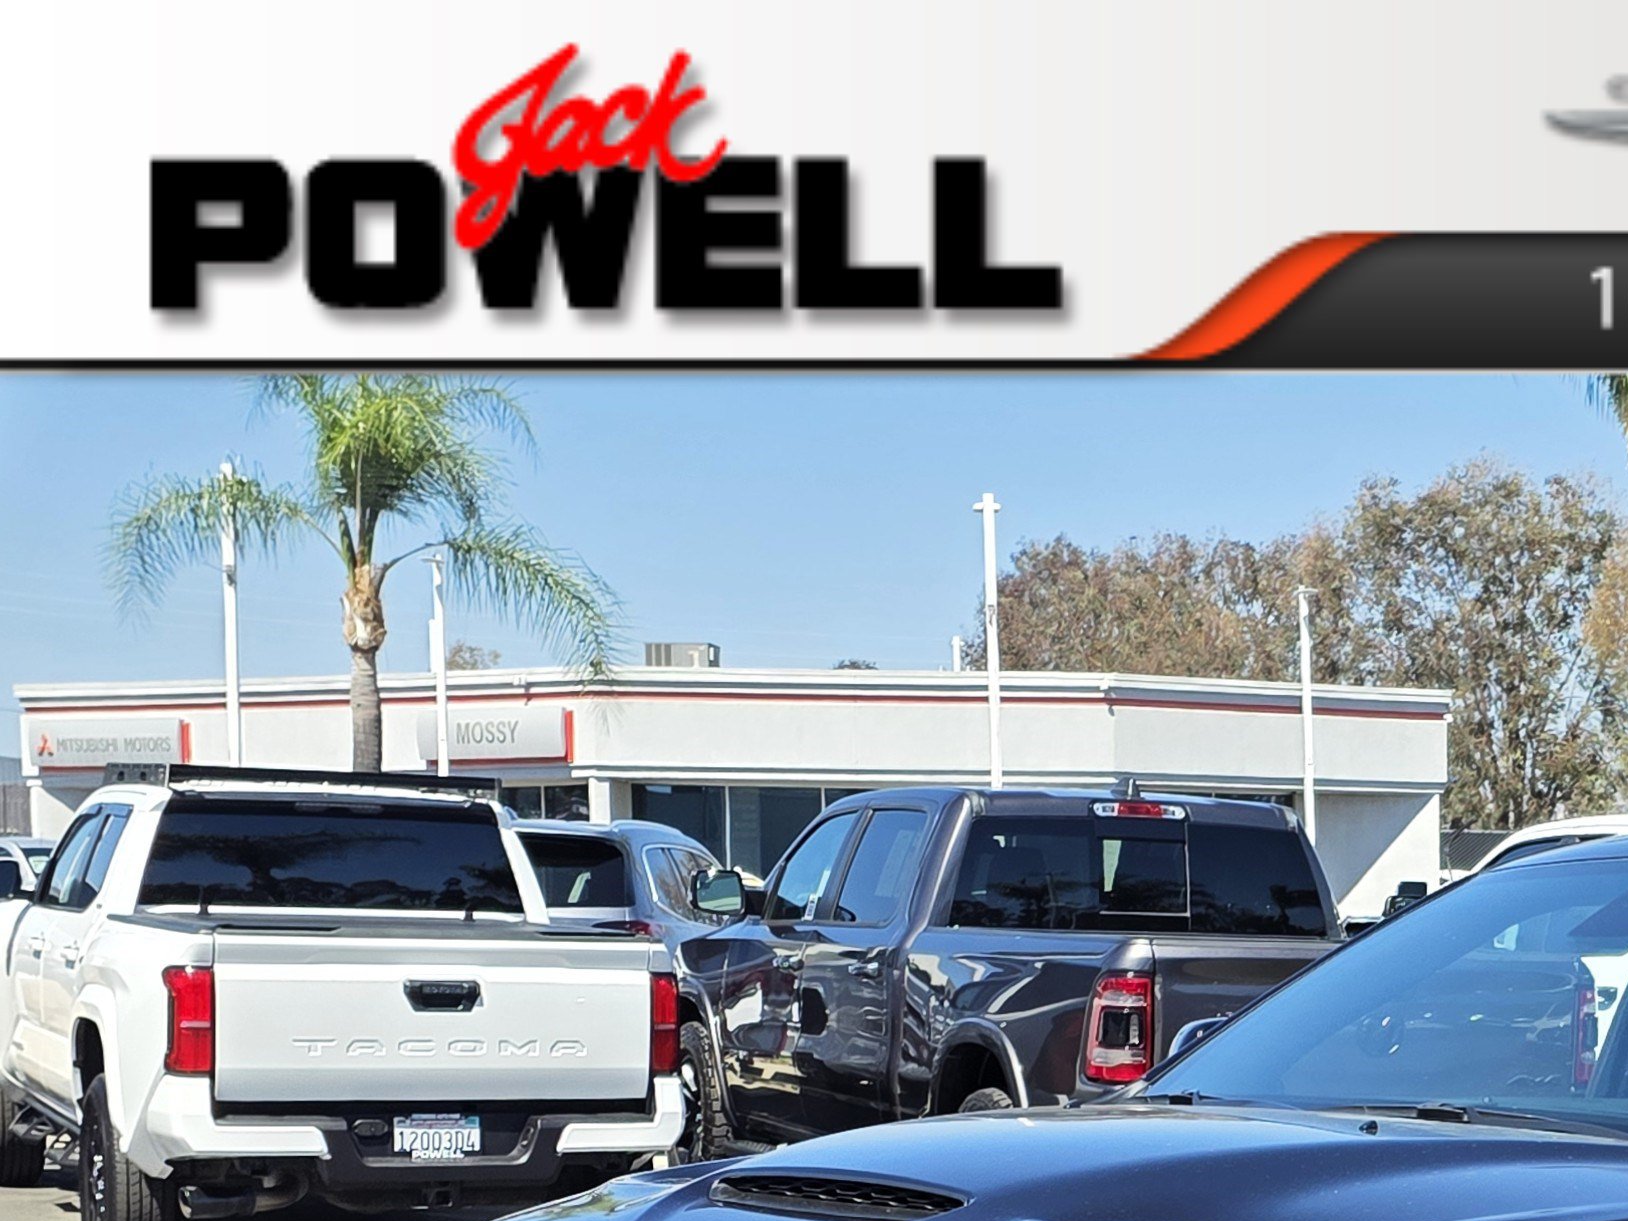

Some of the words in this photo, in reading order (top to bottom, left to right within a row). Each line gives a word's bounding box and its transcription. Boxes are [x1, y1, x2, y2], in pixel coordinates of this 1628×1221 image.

[456, 720, 519, 745] MOSSY
[56, 736, 118, 753] MITSUBISHI
[124, 736, 171, 753] MOTORS
[292, 1038, 588, 1057] TACOMA
